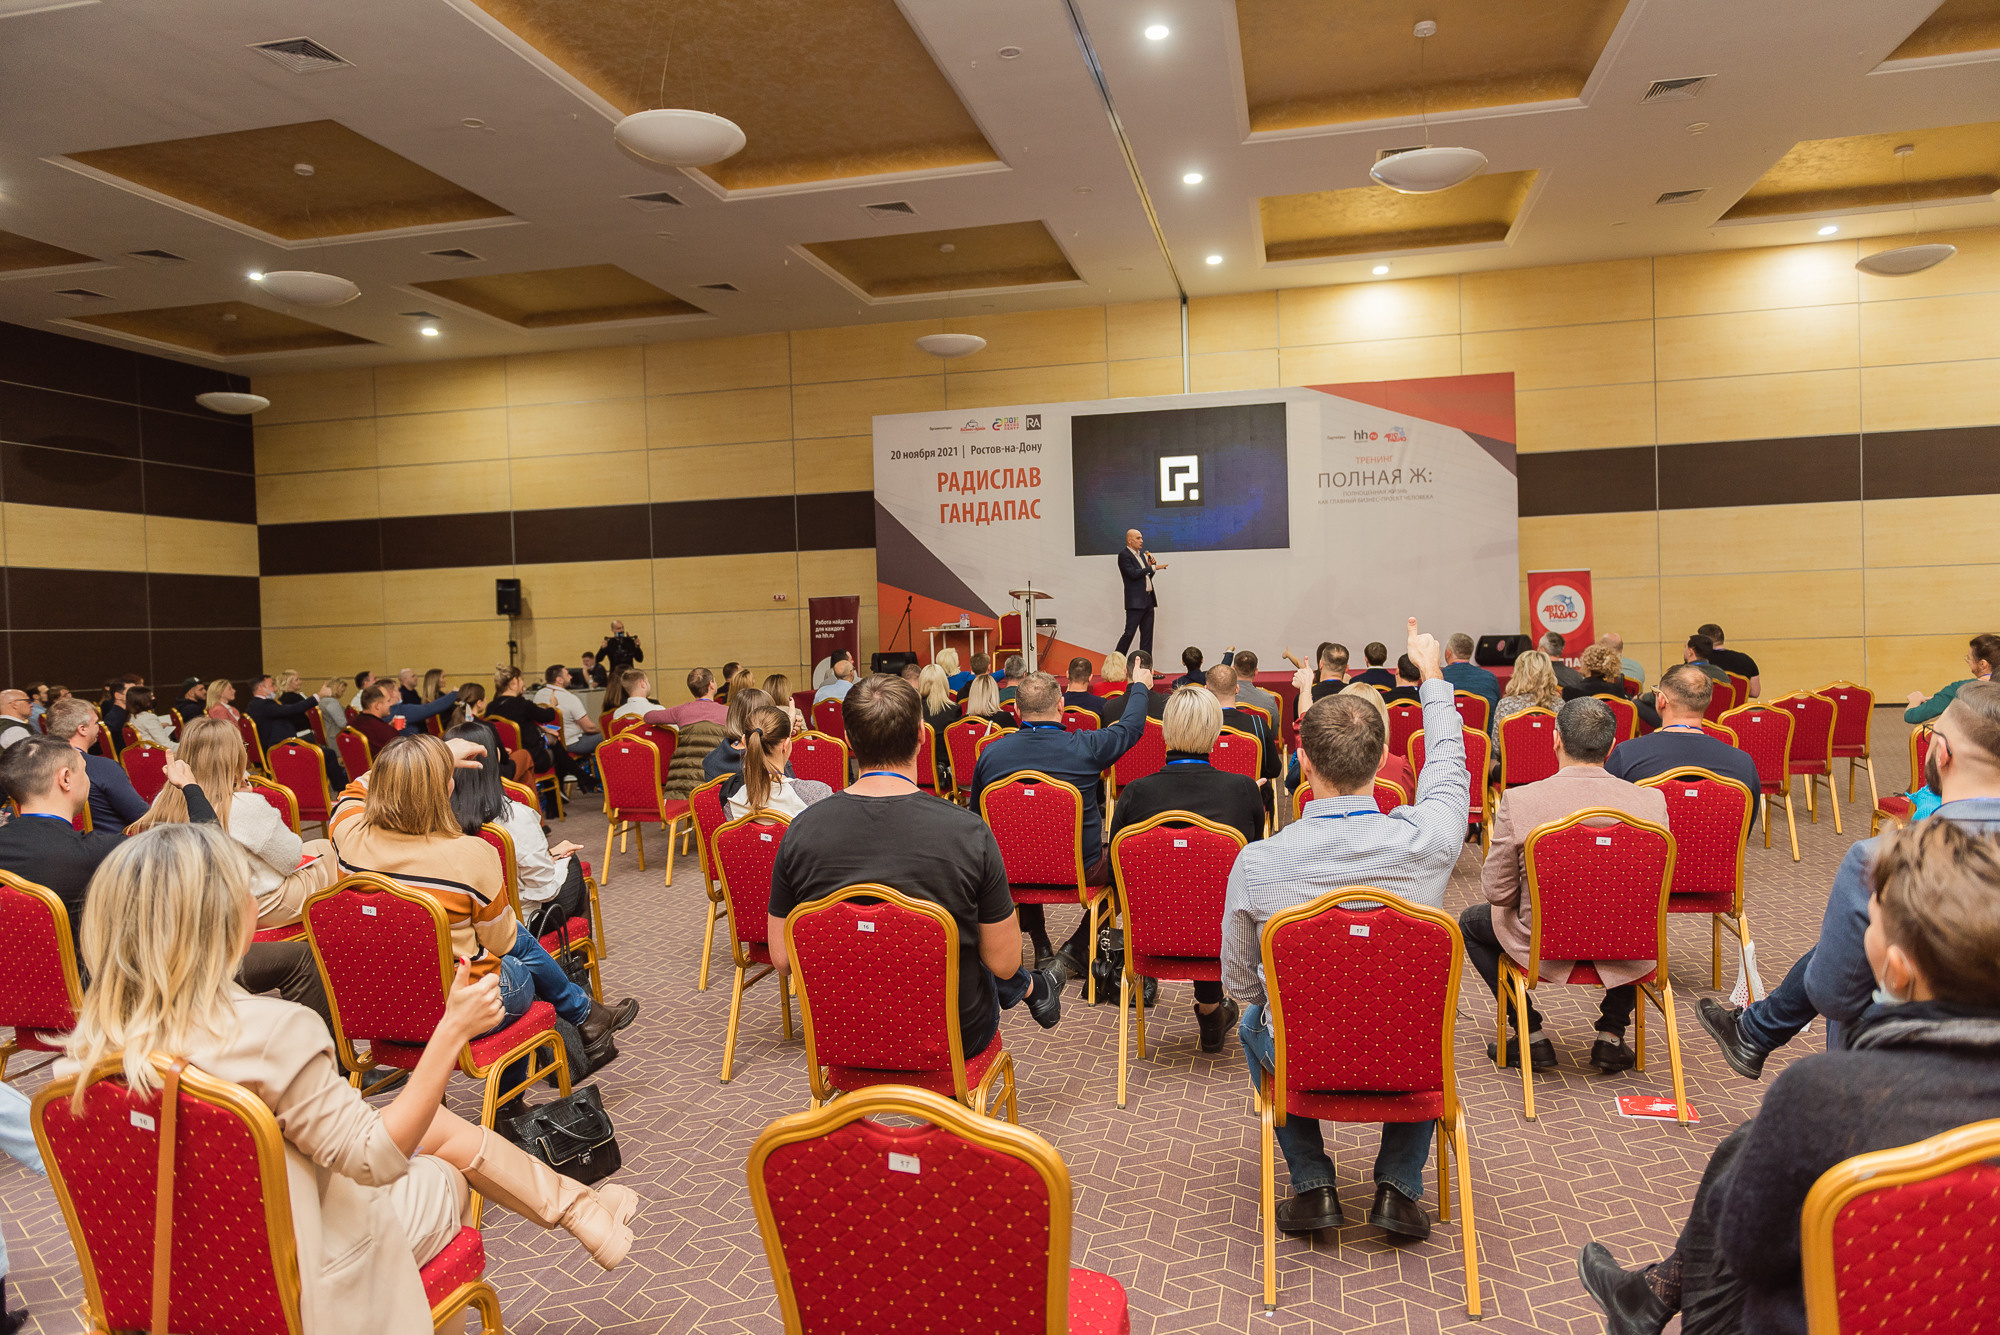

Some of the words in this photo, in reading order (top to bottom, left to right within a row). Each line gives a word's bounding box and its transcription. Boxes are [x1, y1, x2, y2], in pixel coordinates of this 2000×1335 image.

[1027, 417, 1041, 429] RA
[890, 450, 902, 460] 20
[903, 448, 936, 460] ноября
[937, 446, 958, 457] 2021
[970, 441, 1043, 455] Ростов-на-Дону
[1356, 455, 1394, 464] ТРЕНИНГ
[937, 466, 1042, 495] РАДИСЛАВ
[1318, 468, 1402, 488] ПОЛНАЯ
[1409, 467, 1433, 484] Ж:
[940, 498, 1041, 526] ГАНДАПАС
